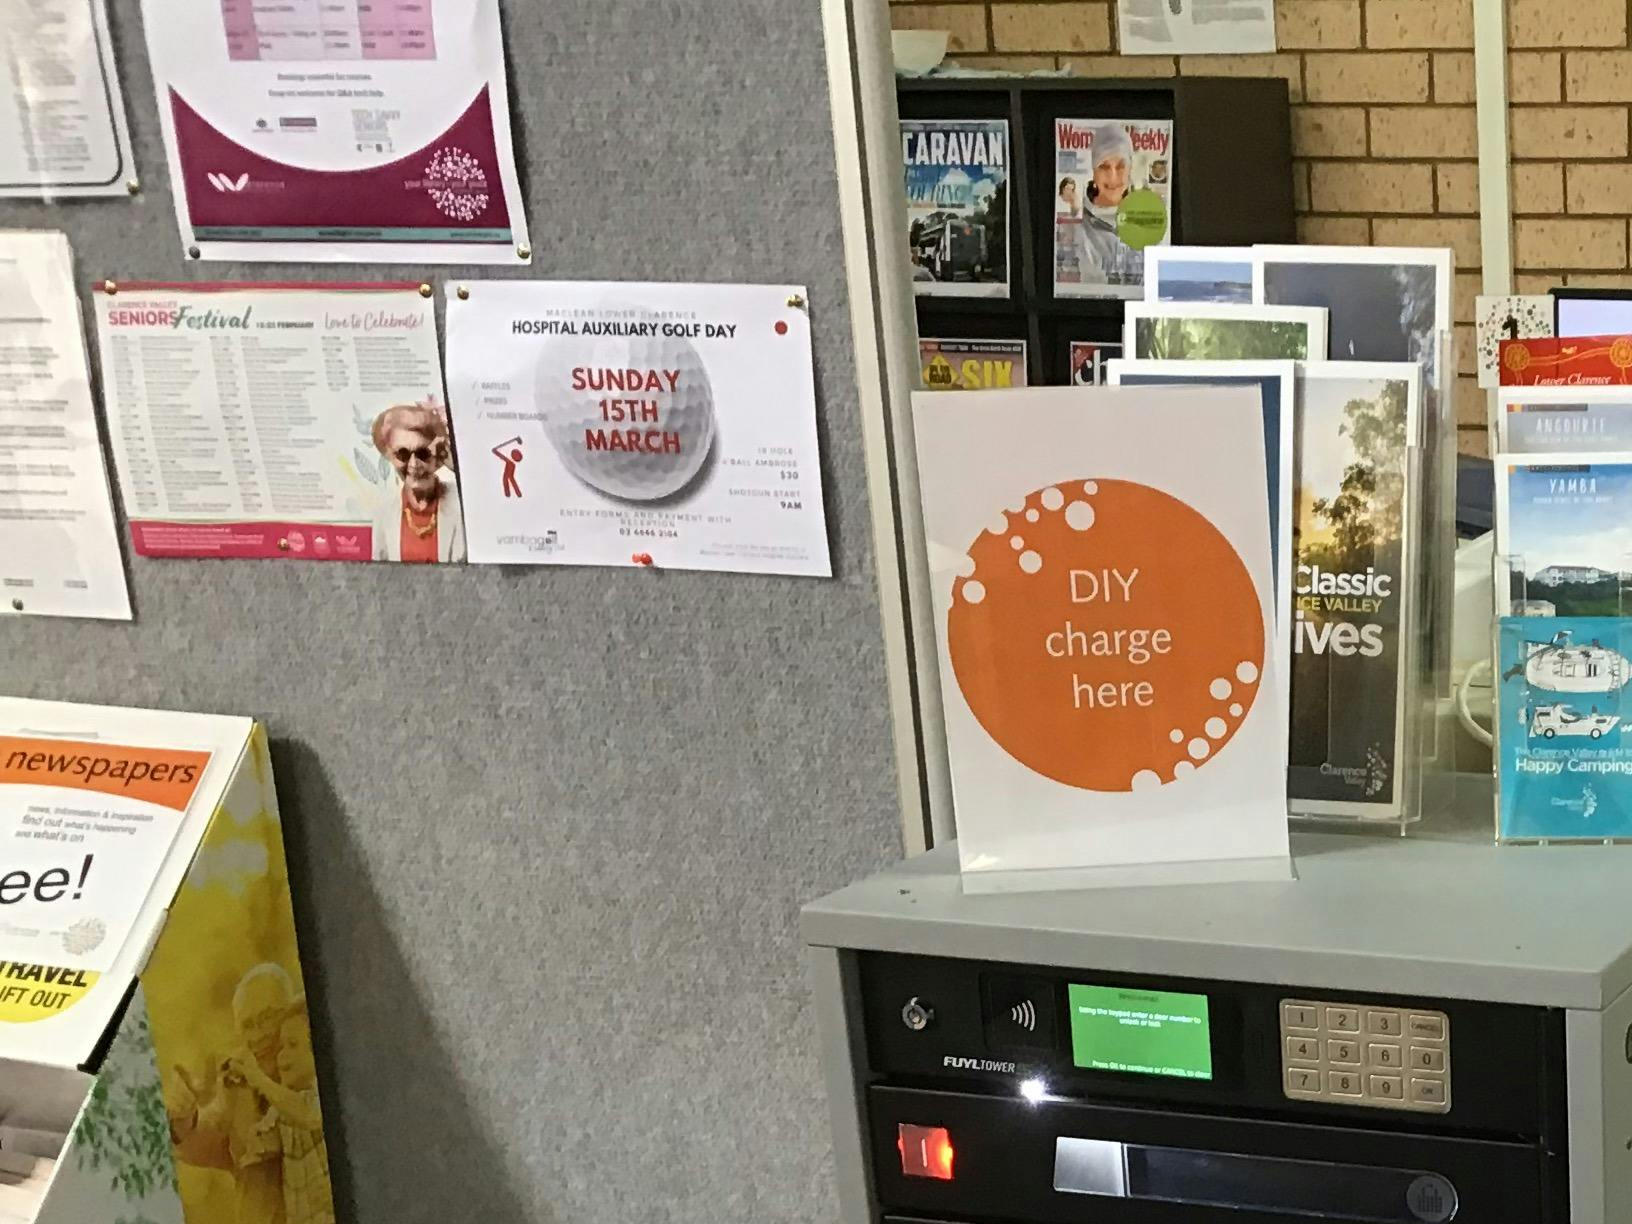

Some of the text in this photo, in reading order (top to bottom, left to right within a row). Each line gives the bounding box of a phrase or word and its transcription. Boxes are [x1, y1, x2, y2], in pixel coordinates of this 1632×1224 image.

[903, 131, 1003, 165] CARAVAN
[109, 305, 252, 329] SENIORS Festival
[325, 312, 347, 329] Love
[1502, 317, 1517, 339] 1
[512, 321, 736, 338] HOSPITAL AUXILIARY GOLF DAY
[571, 367, 680, 392] SUNDAY
[962, 359, 1013, 389] SIX
[1535, 372, 1611, 385] Lower Clarence
[600, 400, 658, 422] 15TH
[1536, 417, 1605, 433] ANGOURIE
[586, 429, 681, 454] MARCH
[781, 470, 798, 480] $30
[1550, 478, 1596, 494] YAMBA
[780, 501, 802, 509] 9AM
[1069, 567, 1139, 603] DIY
[1296, 565, 1391, 597] Classic
[1324, 597, 1382, 613] VALLEY
[1046, 621, 1172, 664] charge
[1073, 674, 1154, 708] here
[5, 749, 198, 785] newspapers
[1515, 758, 1564, 774] Happy
[22, 815, 136, 835] find out happening
[33, 831, 84, 842] what's on
[0, 960, 87, 988] TRAVEL
[30, 990, 72, 1009] OUT
[1338, 1015, 1346, 1026] 2
[1380, 1018, 1388, 1030] 3
[1299, 1043, 1431, 1065] 4 5 6 0
[1301, 1074, 1390, 1094] 7 8 9
[920, 1139, 929, 1167] 1
